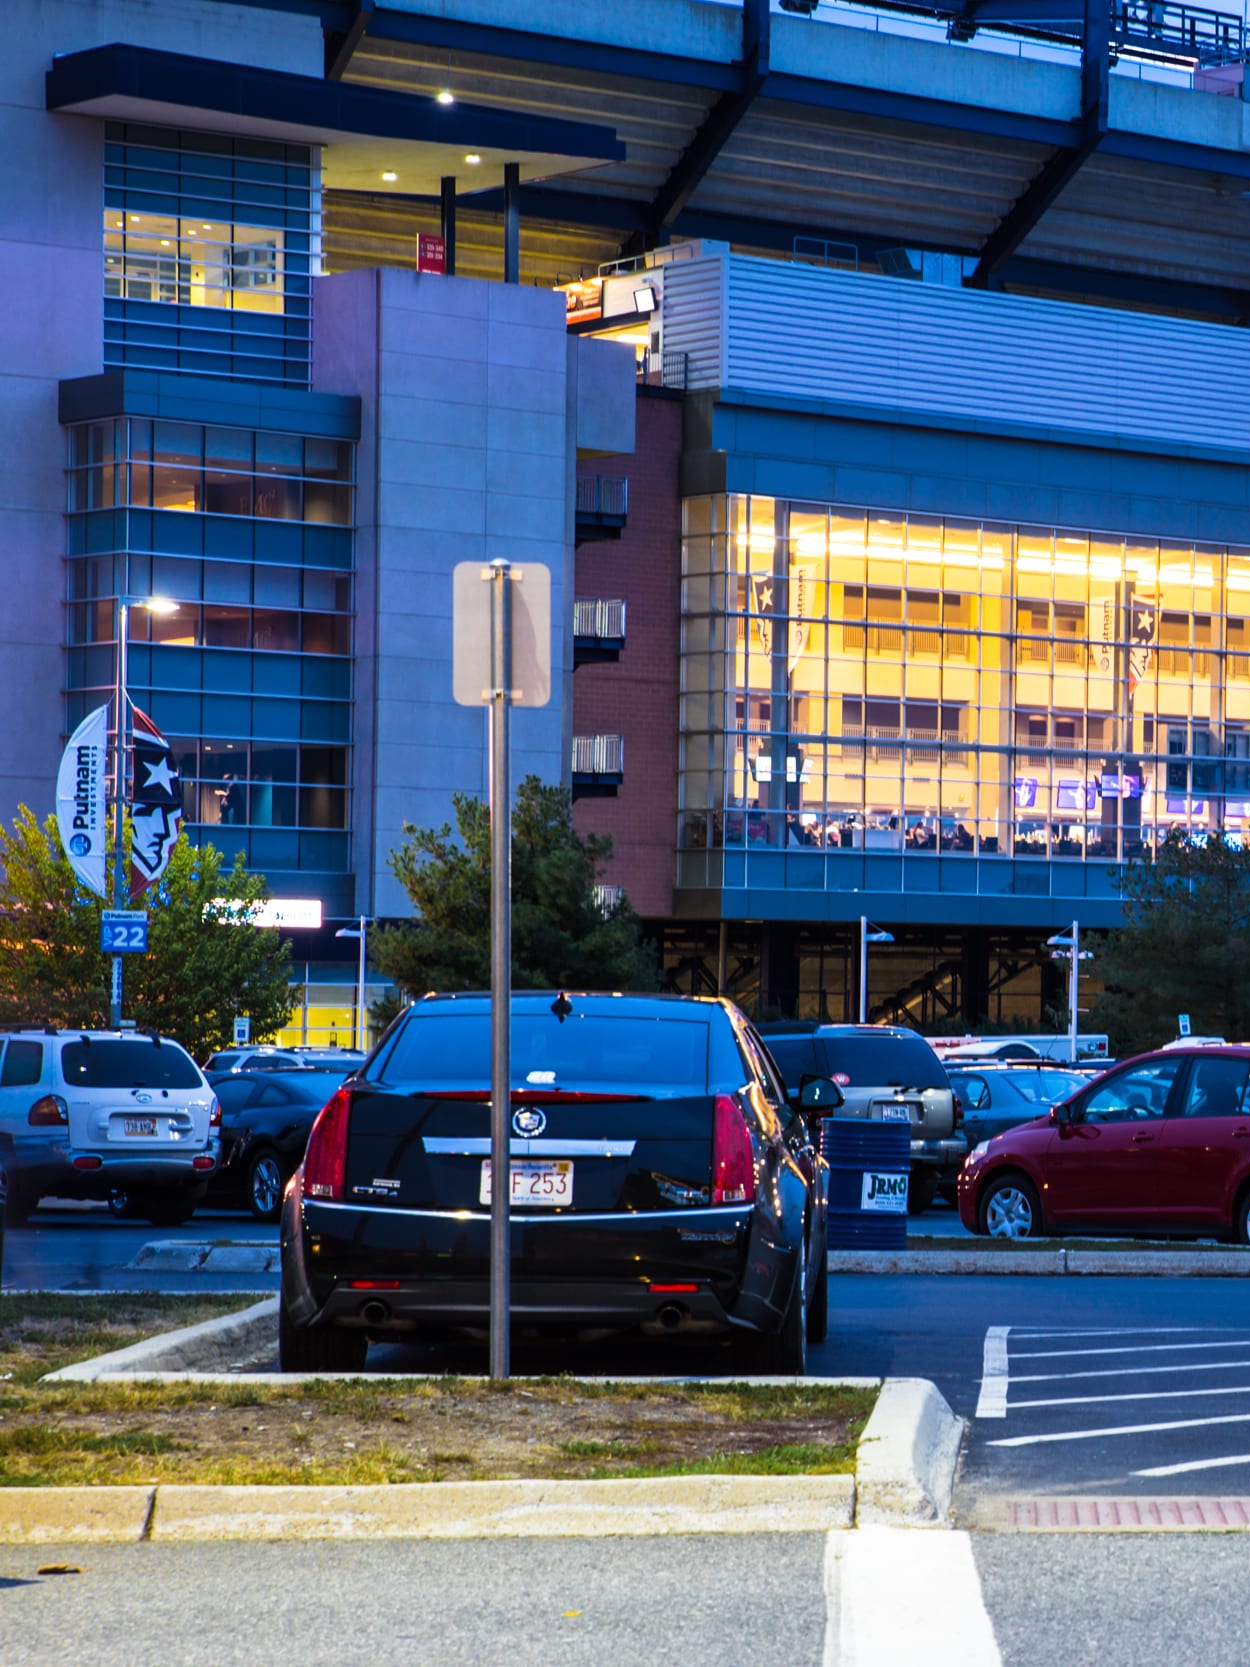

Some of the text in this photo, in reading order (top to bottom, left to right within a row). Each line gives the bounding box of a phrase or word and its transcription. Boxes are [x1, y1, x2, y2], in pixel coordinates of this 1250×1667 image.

[73, 745, 90, 829] Putnam
[90, 745, 98, 830] INVESTMENTS
[104, 925, 112, 947] VIP
[113, 926, 145, 947] 22
[529, 1172, 568, 1194] 253
